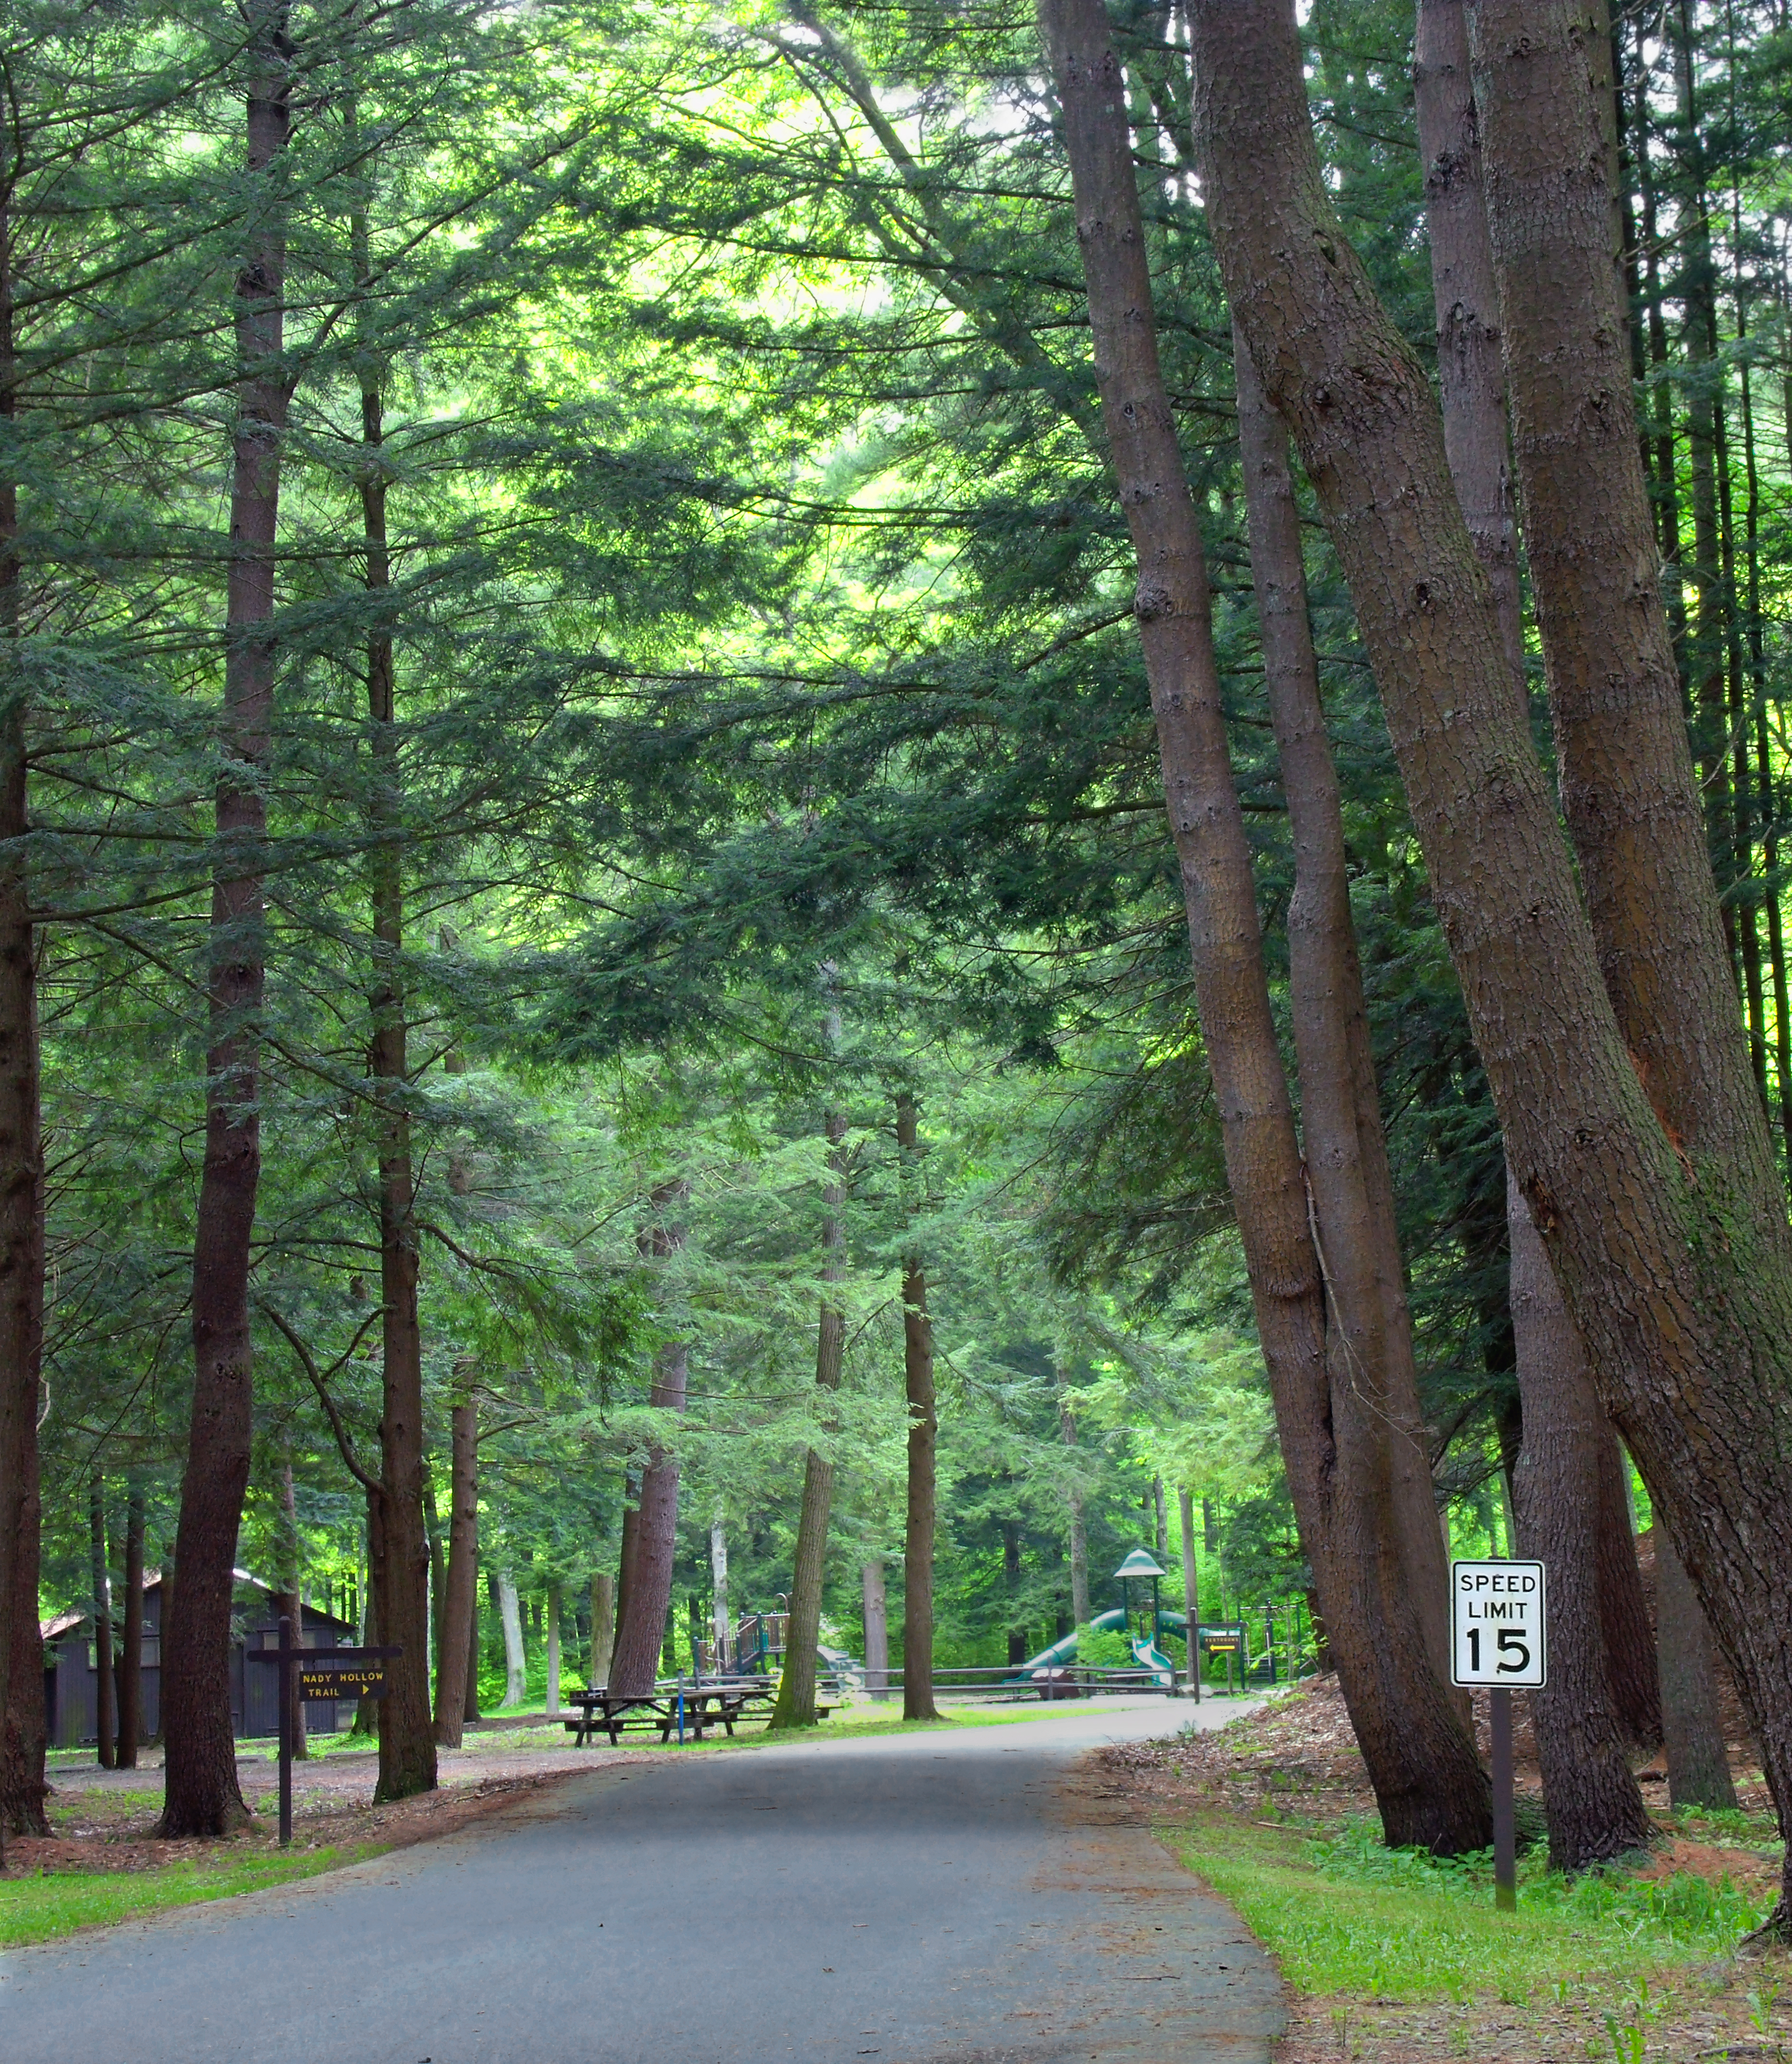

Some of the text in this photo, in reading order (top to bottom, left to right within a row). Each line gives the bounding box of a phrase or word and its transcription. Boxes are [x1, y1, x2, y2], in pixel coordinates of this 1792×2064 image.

[1460, 1574, 1536, 1592] SPEED
[1468, 1602, 1528, 1619] LIMIT
[1467, 1628, 1530, 1673] 15
[303, 1672, 383, 1683] NADY HOLLOW
[308, 1688, 339, 1697] TRAIL
